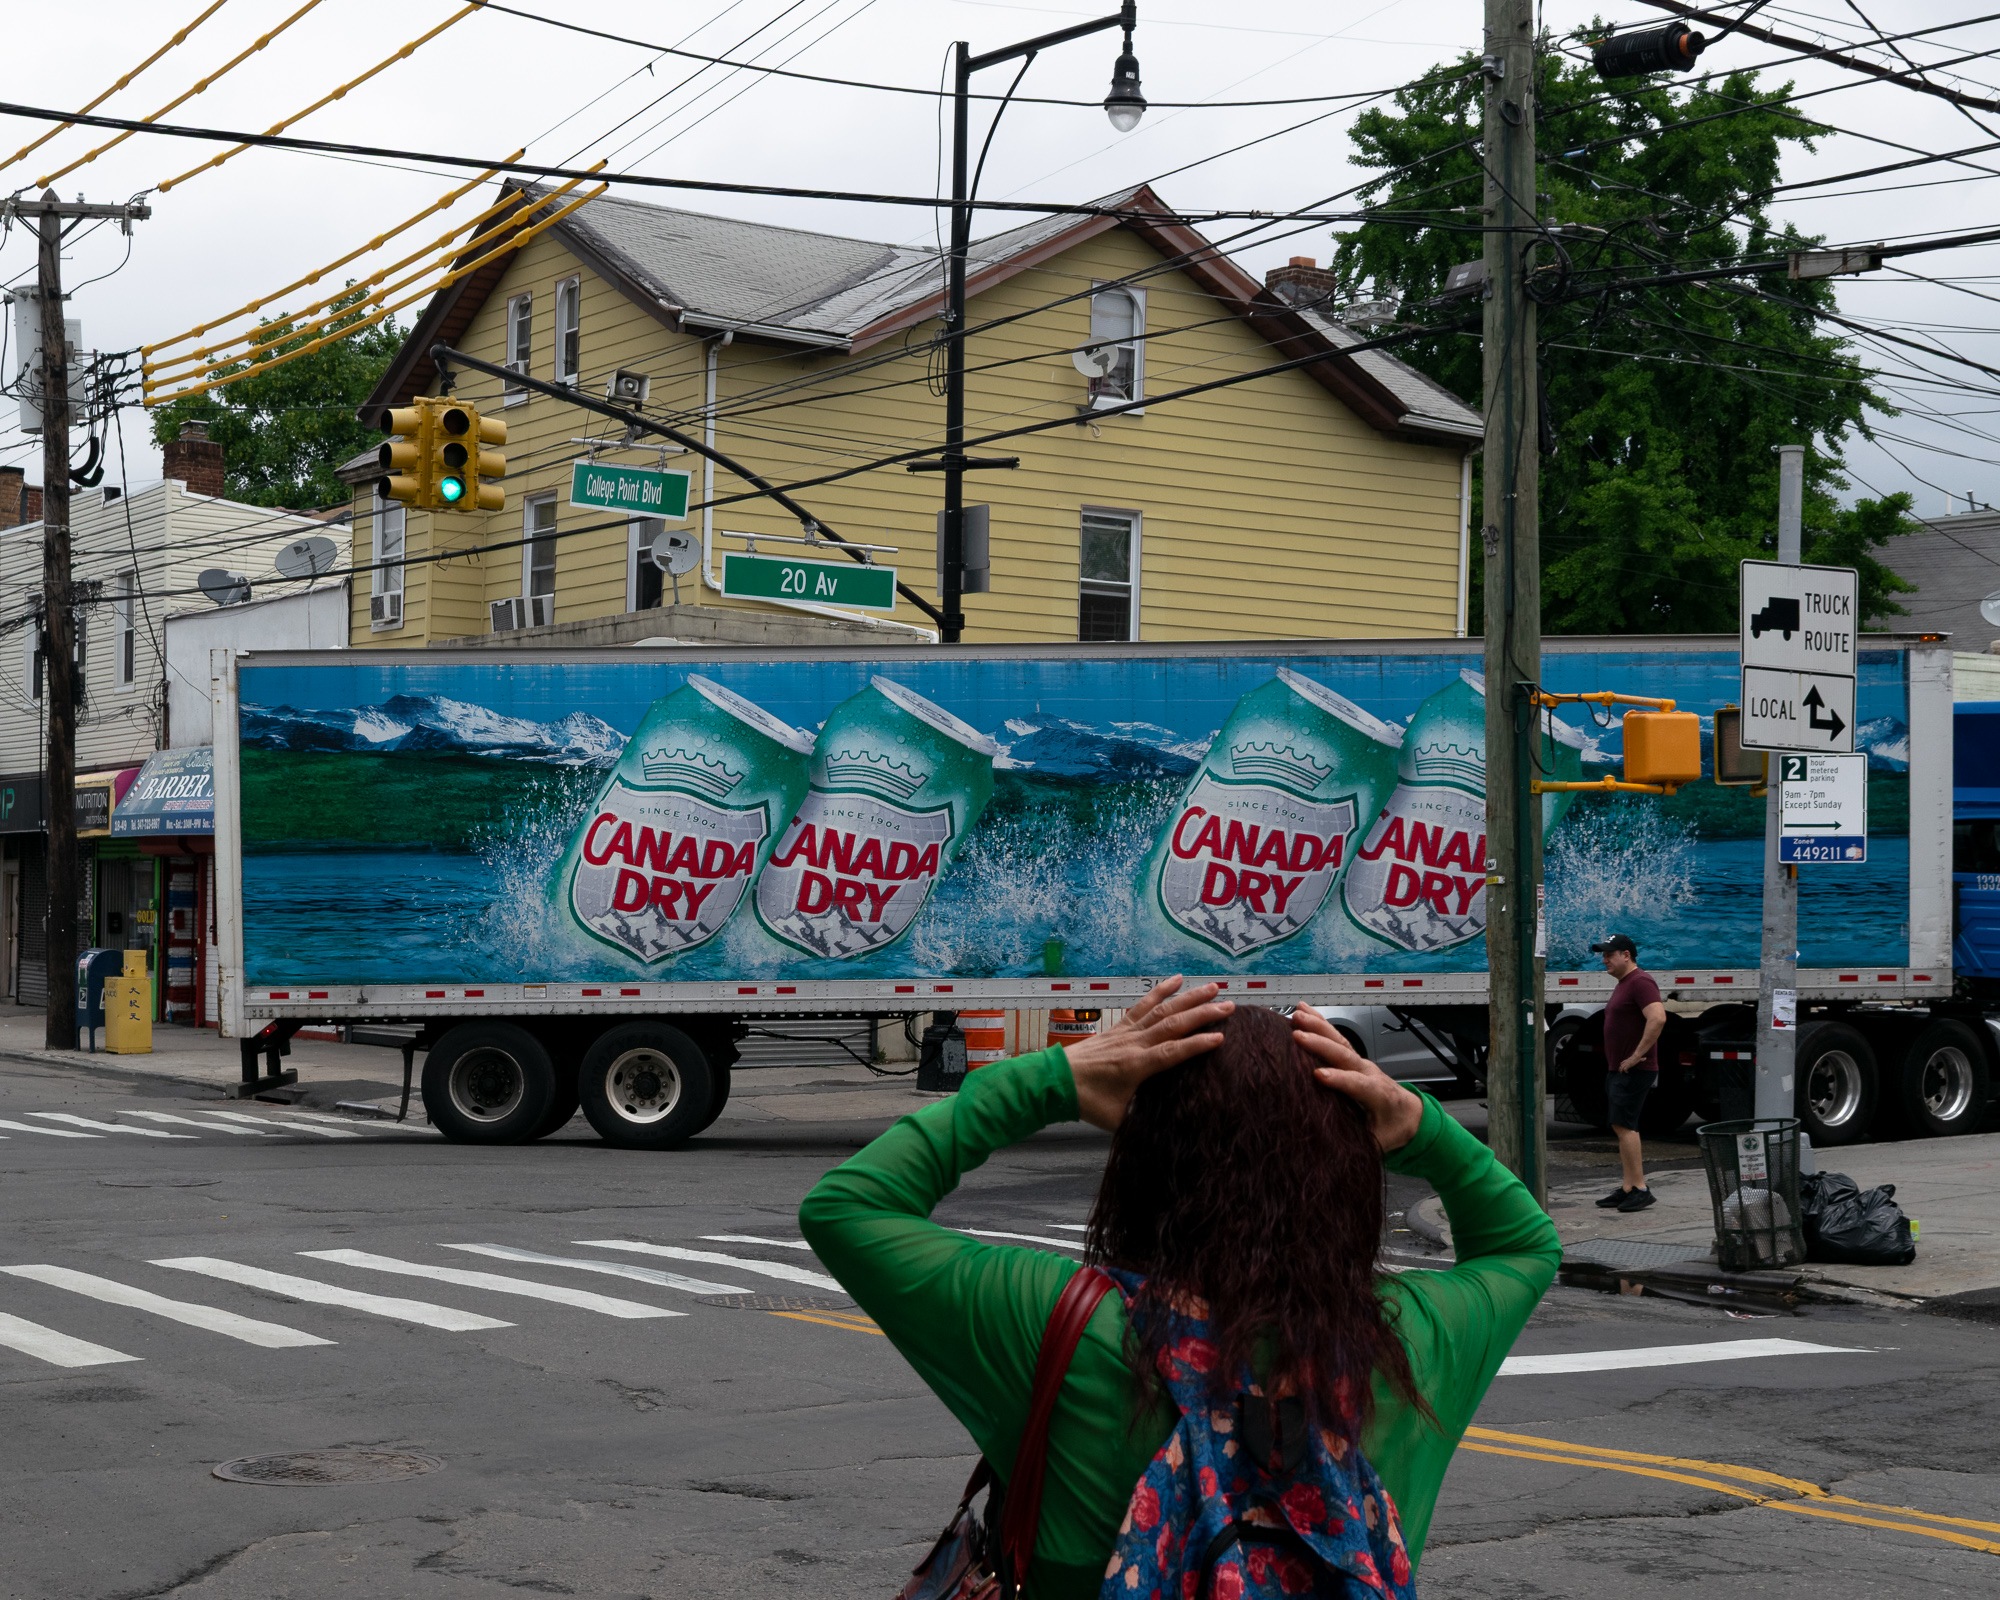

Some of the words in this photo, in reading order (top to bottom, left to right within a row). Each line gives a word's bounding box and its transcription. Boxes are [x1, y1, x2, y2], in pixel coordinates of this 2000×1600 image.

[586, 473, 615, 505] College
[618, 478, 640, 502] Point
[642, 480, 662, 505] Blvd
[780, 568, 807, 594] 20
[814, 572, 838, 596] Av
[1804, 592, 1850, 616] TRUCK
[1804, 630, 1850, 653] ROUTE
[1751, 696, 1797, 721] LOCAL
[1787, 758, 1801, 780] 2
[140, 774, 210, 800] BARBER
[1784, 790, 1801, 798] 9am
[1810, 790, 1826, 799] 7pm
[76, 792, 108, 810] NUTRITION
[1228, 800, 1269, 812] SINCE
[1274, 806, 1306, 824] 1904
[1412, 802, 1452, 812] SINCE
[1784, 800, 1812, 810] Except
[1814, 800, 1842, 810] Sunday
[639, 806, 680, 818] SINCE
[686, 812, 717, 830] 1904
[823, 809, 865, 820] SINCE
[870, 815, 901, 832] 1904
[583, 812, 758, 880] CANADA
[1171, 806, 1344, 872] CANADA
[1358, 808, 1486, 874] ANA
[1792, 846, 1840, 860] 449211
[612, 868, 717, 921] DRY
[796, 870, 902, 922] DRY
[1201, 862, 1306, 914] DRY
[1384, 862, 1486, 916] DRY
[137, 910, 155, 923] GOLD
[129, 986, 140, 1021] 大紀元
